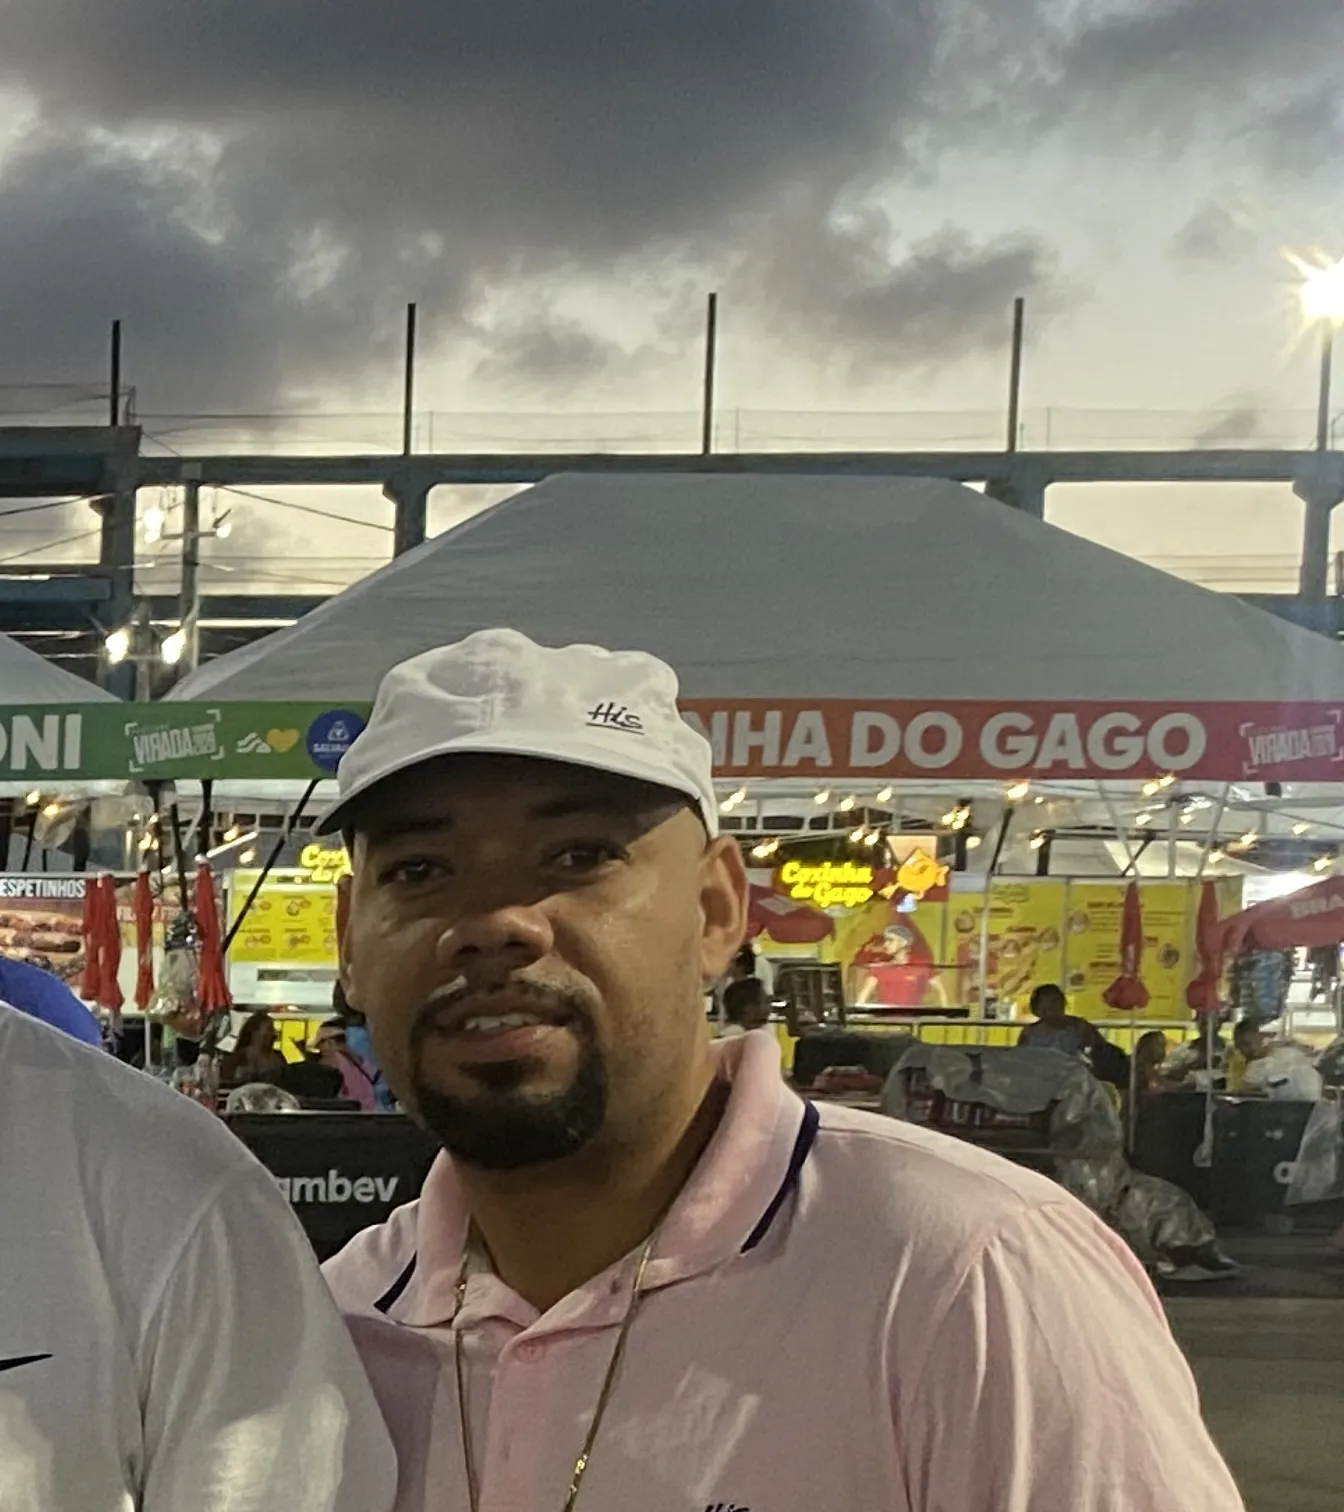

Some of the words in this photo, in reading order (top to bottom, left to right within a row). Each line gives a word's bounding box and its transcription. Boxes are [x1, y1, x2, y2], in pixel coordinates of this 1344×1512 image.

[849, 711, 962, 768] DO
[979, 712, 1208, 771] GAGO
[0, 878, 86, 898] ESPETINHOS
